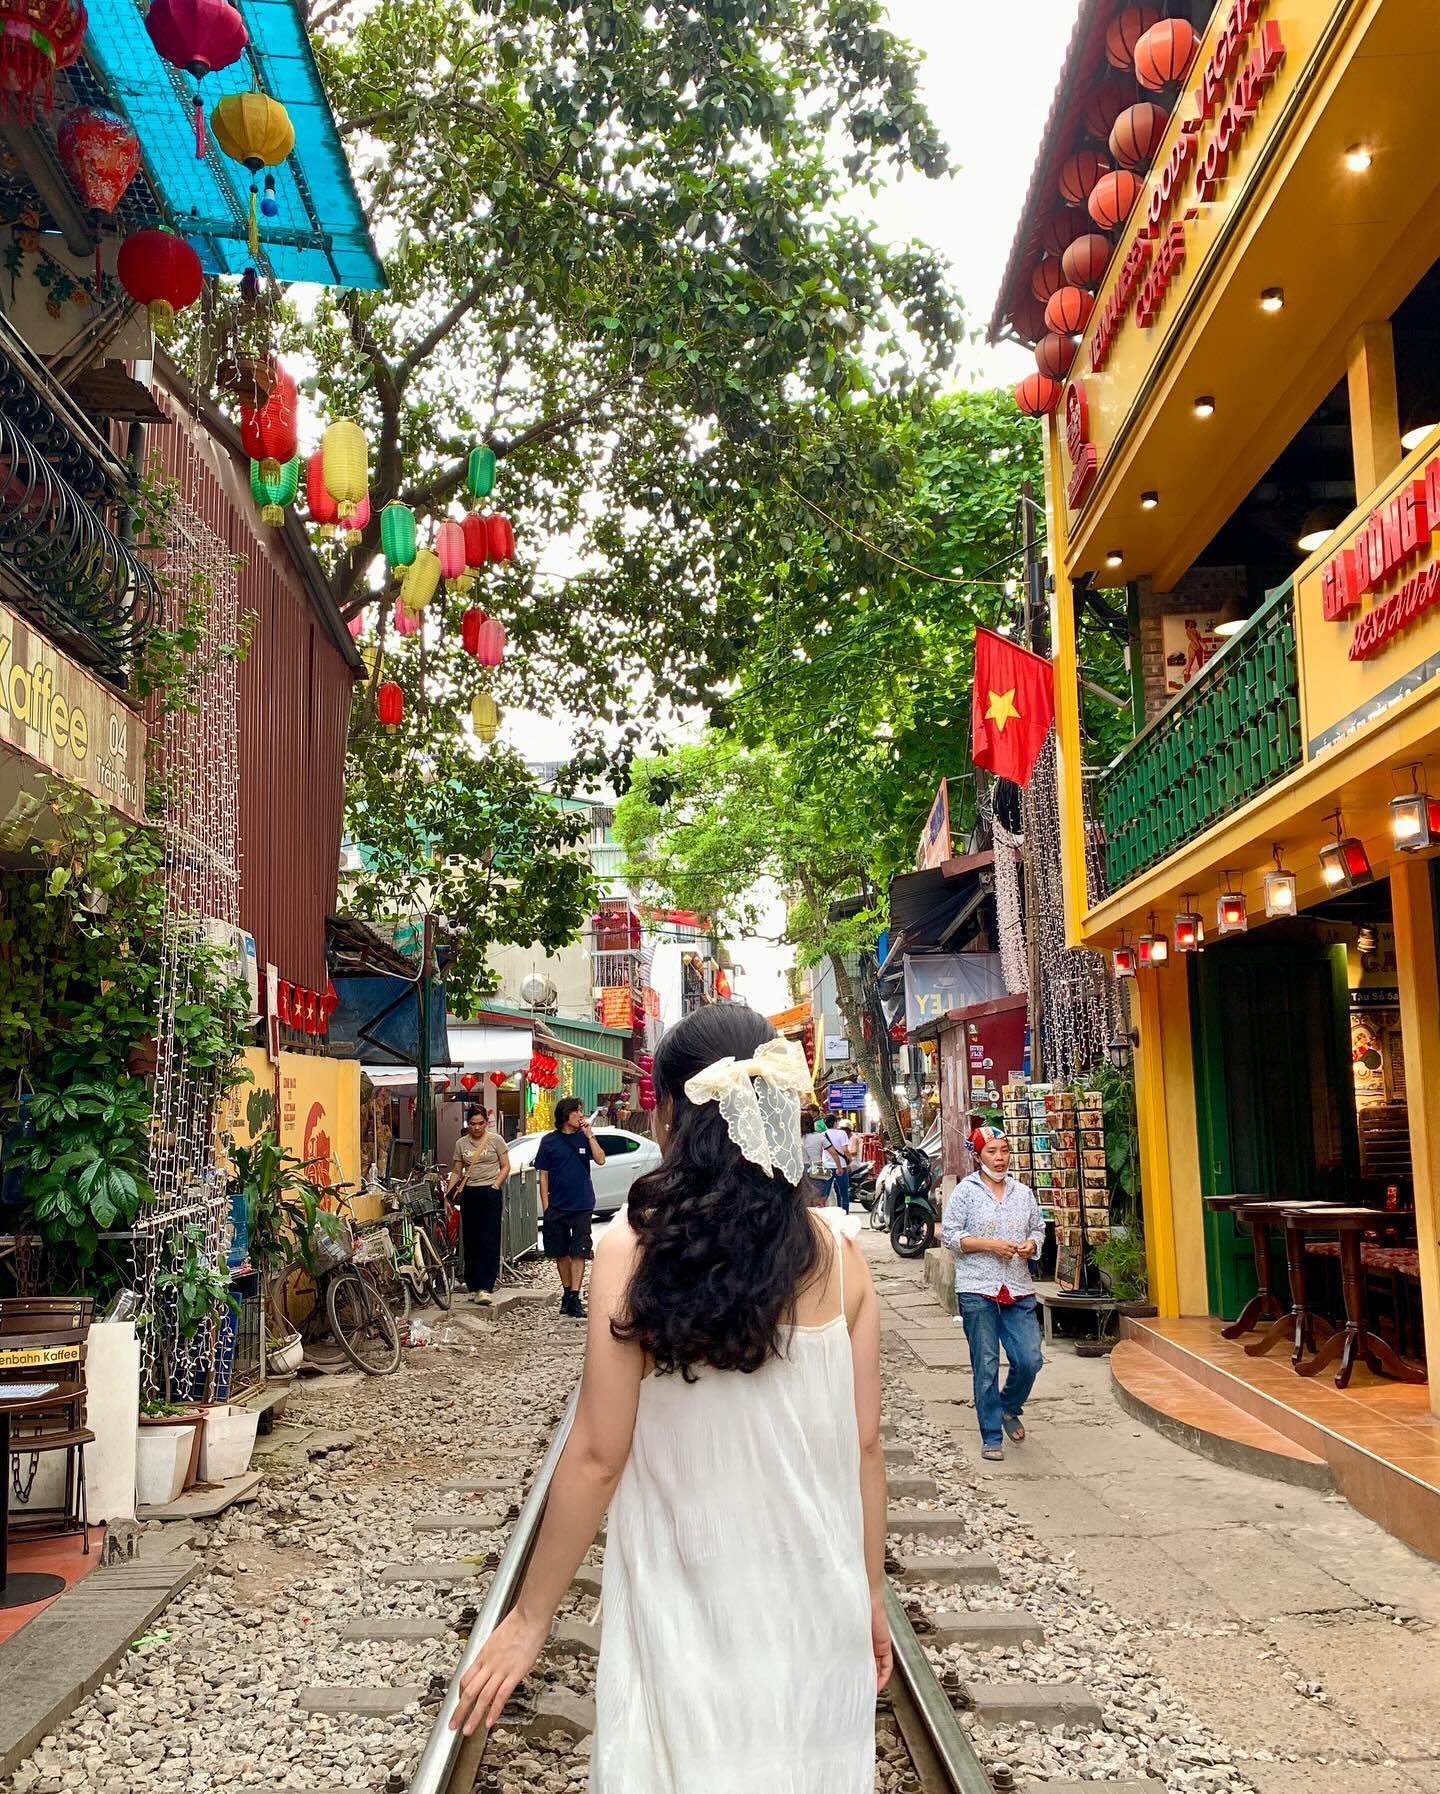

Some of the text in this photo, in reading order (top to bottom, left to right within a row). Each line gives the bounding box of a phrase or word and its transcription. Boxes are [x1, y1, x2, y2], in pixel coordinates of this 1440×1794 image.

[109, 713, 129, 764] 04
[96, 756, 138, 807] Trần Phú
[43, 1349, 78, 1362] Kaffee
